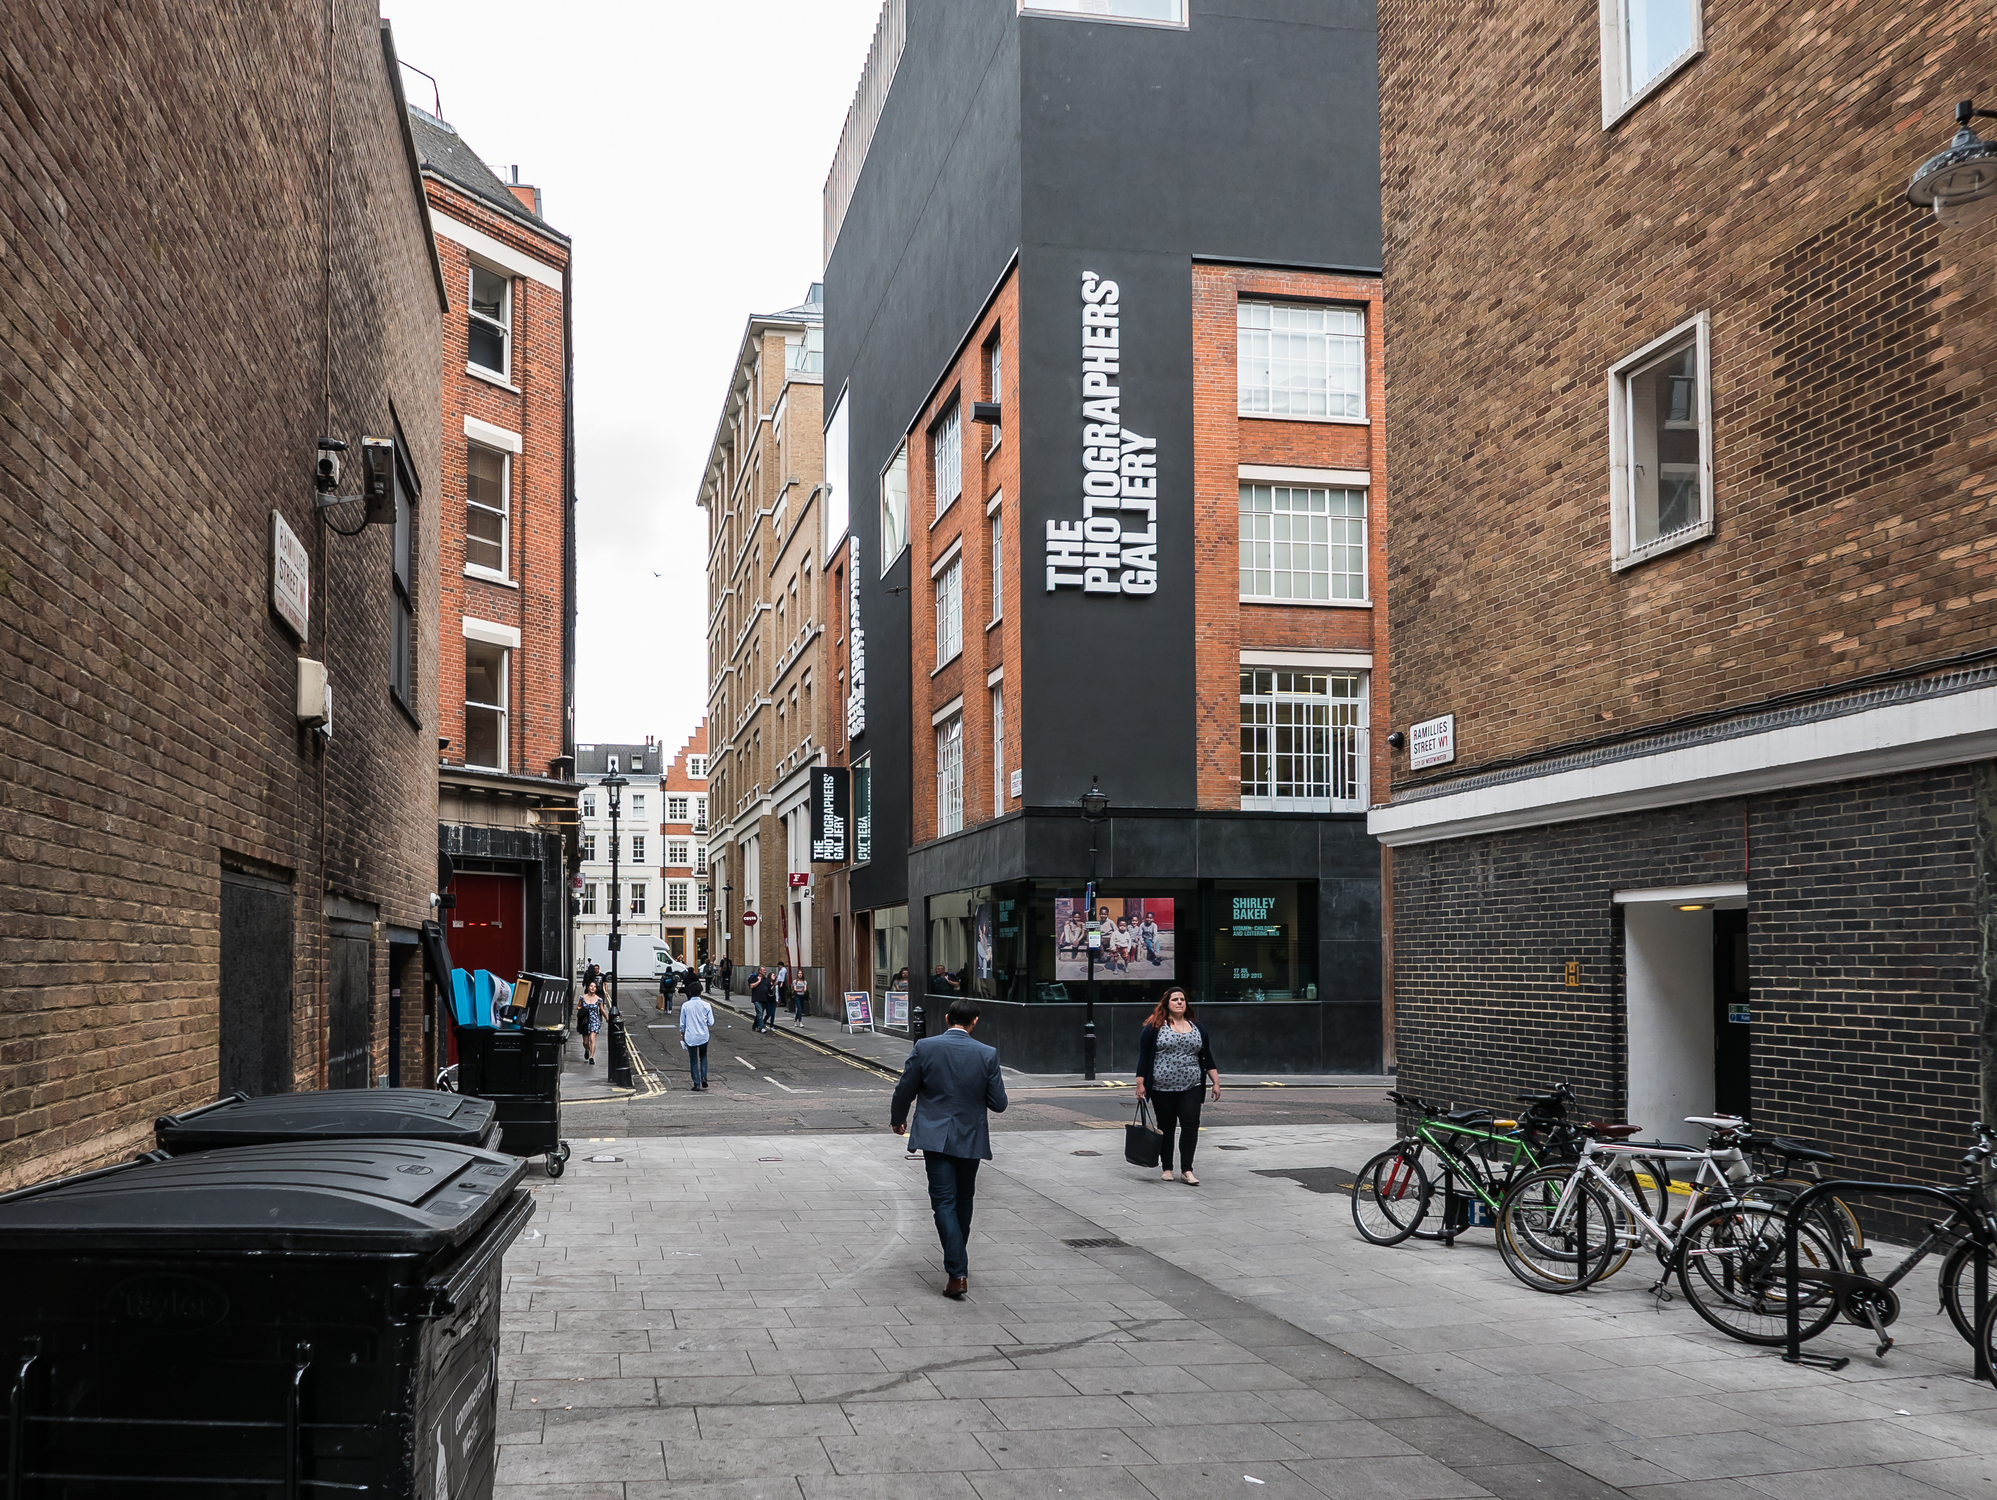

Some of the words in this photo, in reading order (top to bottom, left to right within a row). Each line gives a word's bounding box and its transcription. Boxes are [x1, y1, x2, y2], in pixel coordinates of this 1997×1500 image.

[1081, 270, 1121, 593] PHOTOGRAPHERS'
[1120, 427, 1158, 595] GALLERY
[1046, 519, 1083, 592] THE
[1413, 721, 1448, 741] RAMILLIES
[1413, 738, 1436, 755] STREET
[1438, 735, 1448, 748] W1
[823, 773, 834, 860] PHOTOGRAPHERS'
[834, 815, 844, 860] GALLERY
[813, 839, 824, 859] THE
[1232, 897, 1275, 909] SHIRLEY
[1233, 909, 1267, 920] BAKER
[456, 1361, 491, 1436] commercial
[462, 1415, 479, 1459] waste
